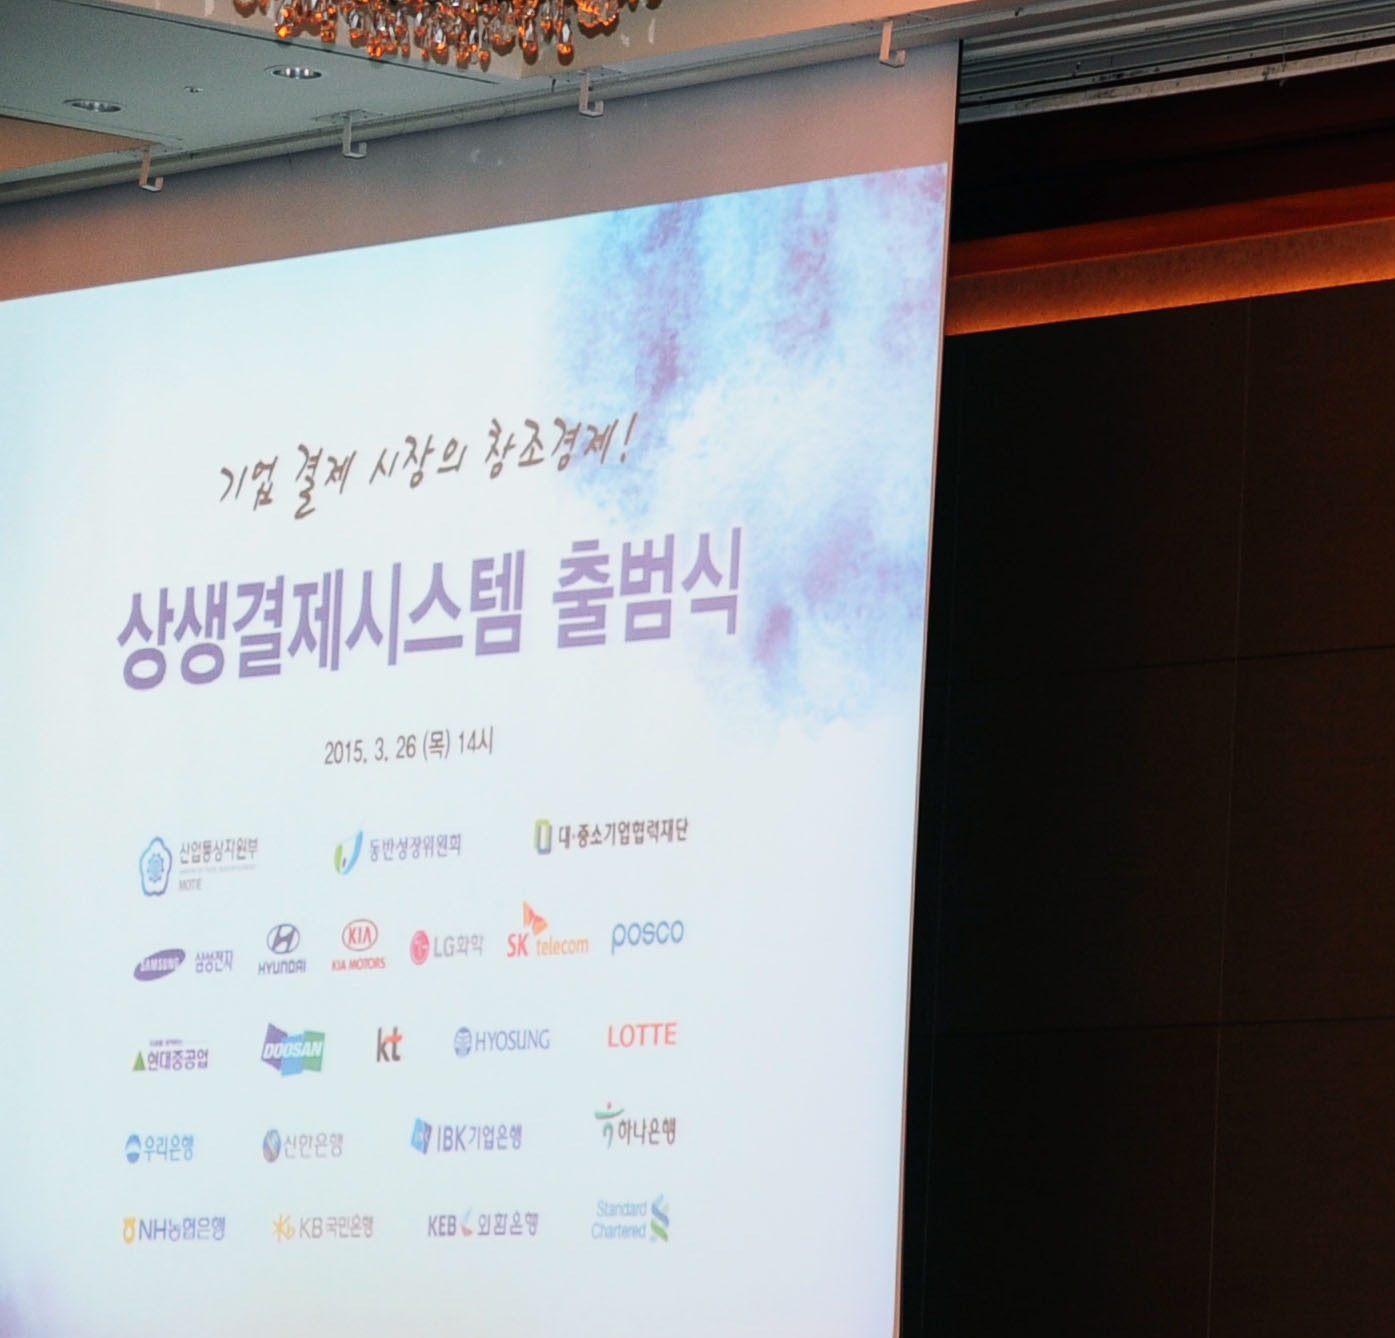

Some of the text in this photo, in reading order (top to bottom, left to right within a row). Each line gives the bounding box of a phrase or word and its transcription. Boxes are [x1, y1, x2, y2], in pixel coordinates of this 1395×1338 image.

[221, 412, 638, 519] 기업 결제 시장의 창조경제!
[116, 527, 744, 691] 상생결제시스템 출범식
[325, 726, 493, 764] 2015. 3. 26 (목) 14시
[370, 833, 461, 862] 동반성장위원회
[507, 934, 589, 957] SK telecom
[611, 920, 684, 954] posco
[259, 959, 306, 974] HYUNDAI
[332, 957, 385, 970] KIA MOTORS
[377, 1027, 402, 1062] kt
[475, 1029, 550, 1051] HYOSUNG
[608, 1023, 676, 1048] LOTTE
[264, 1040, 323, 1059] DOOSAN
[618, 1118, 676, 1145] 하나은행
[143, 1134, 194, 1161] 우리은행
[283, 1133, 344, 1159] 신한은행
[597, 1200, 647, 1217] Standard
[428, 1215, 456, 1236] KEB
[592, 1222, 646, 1239] Chartered
